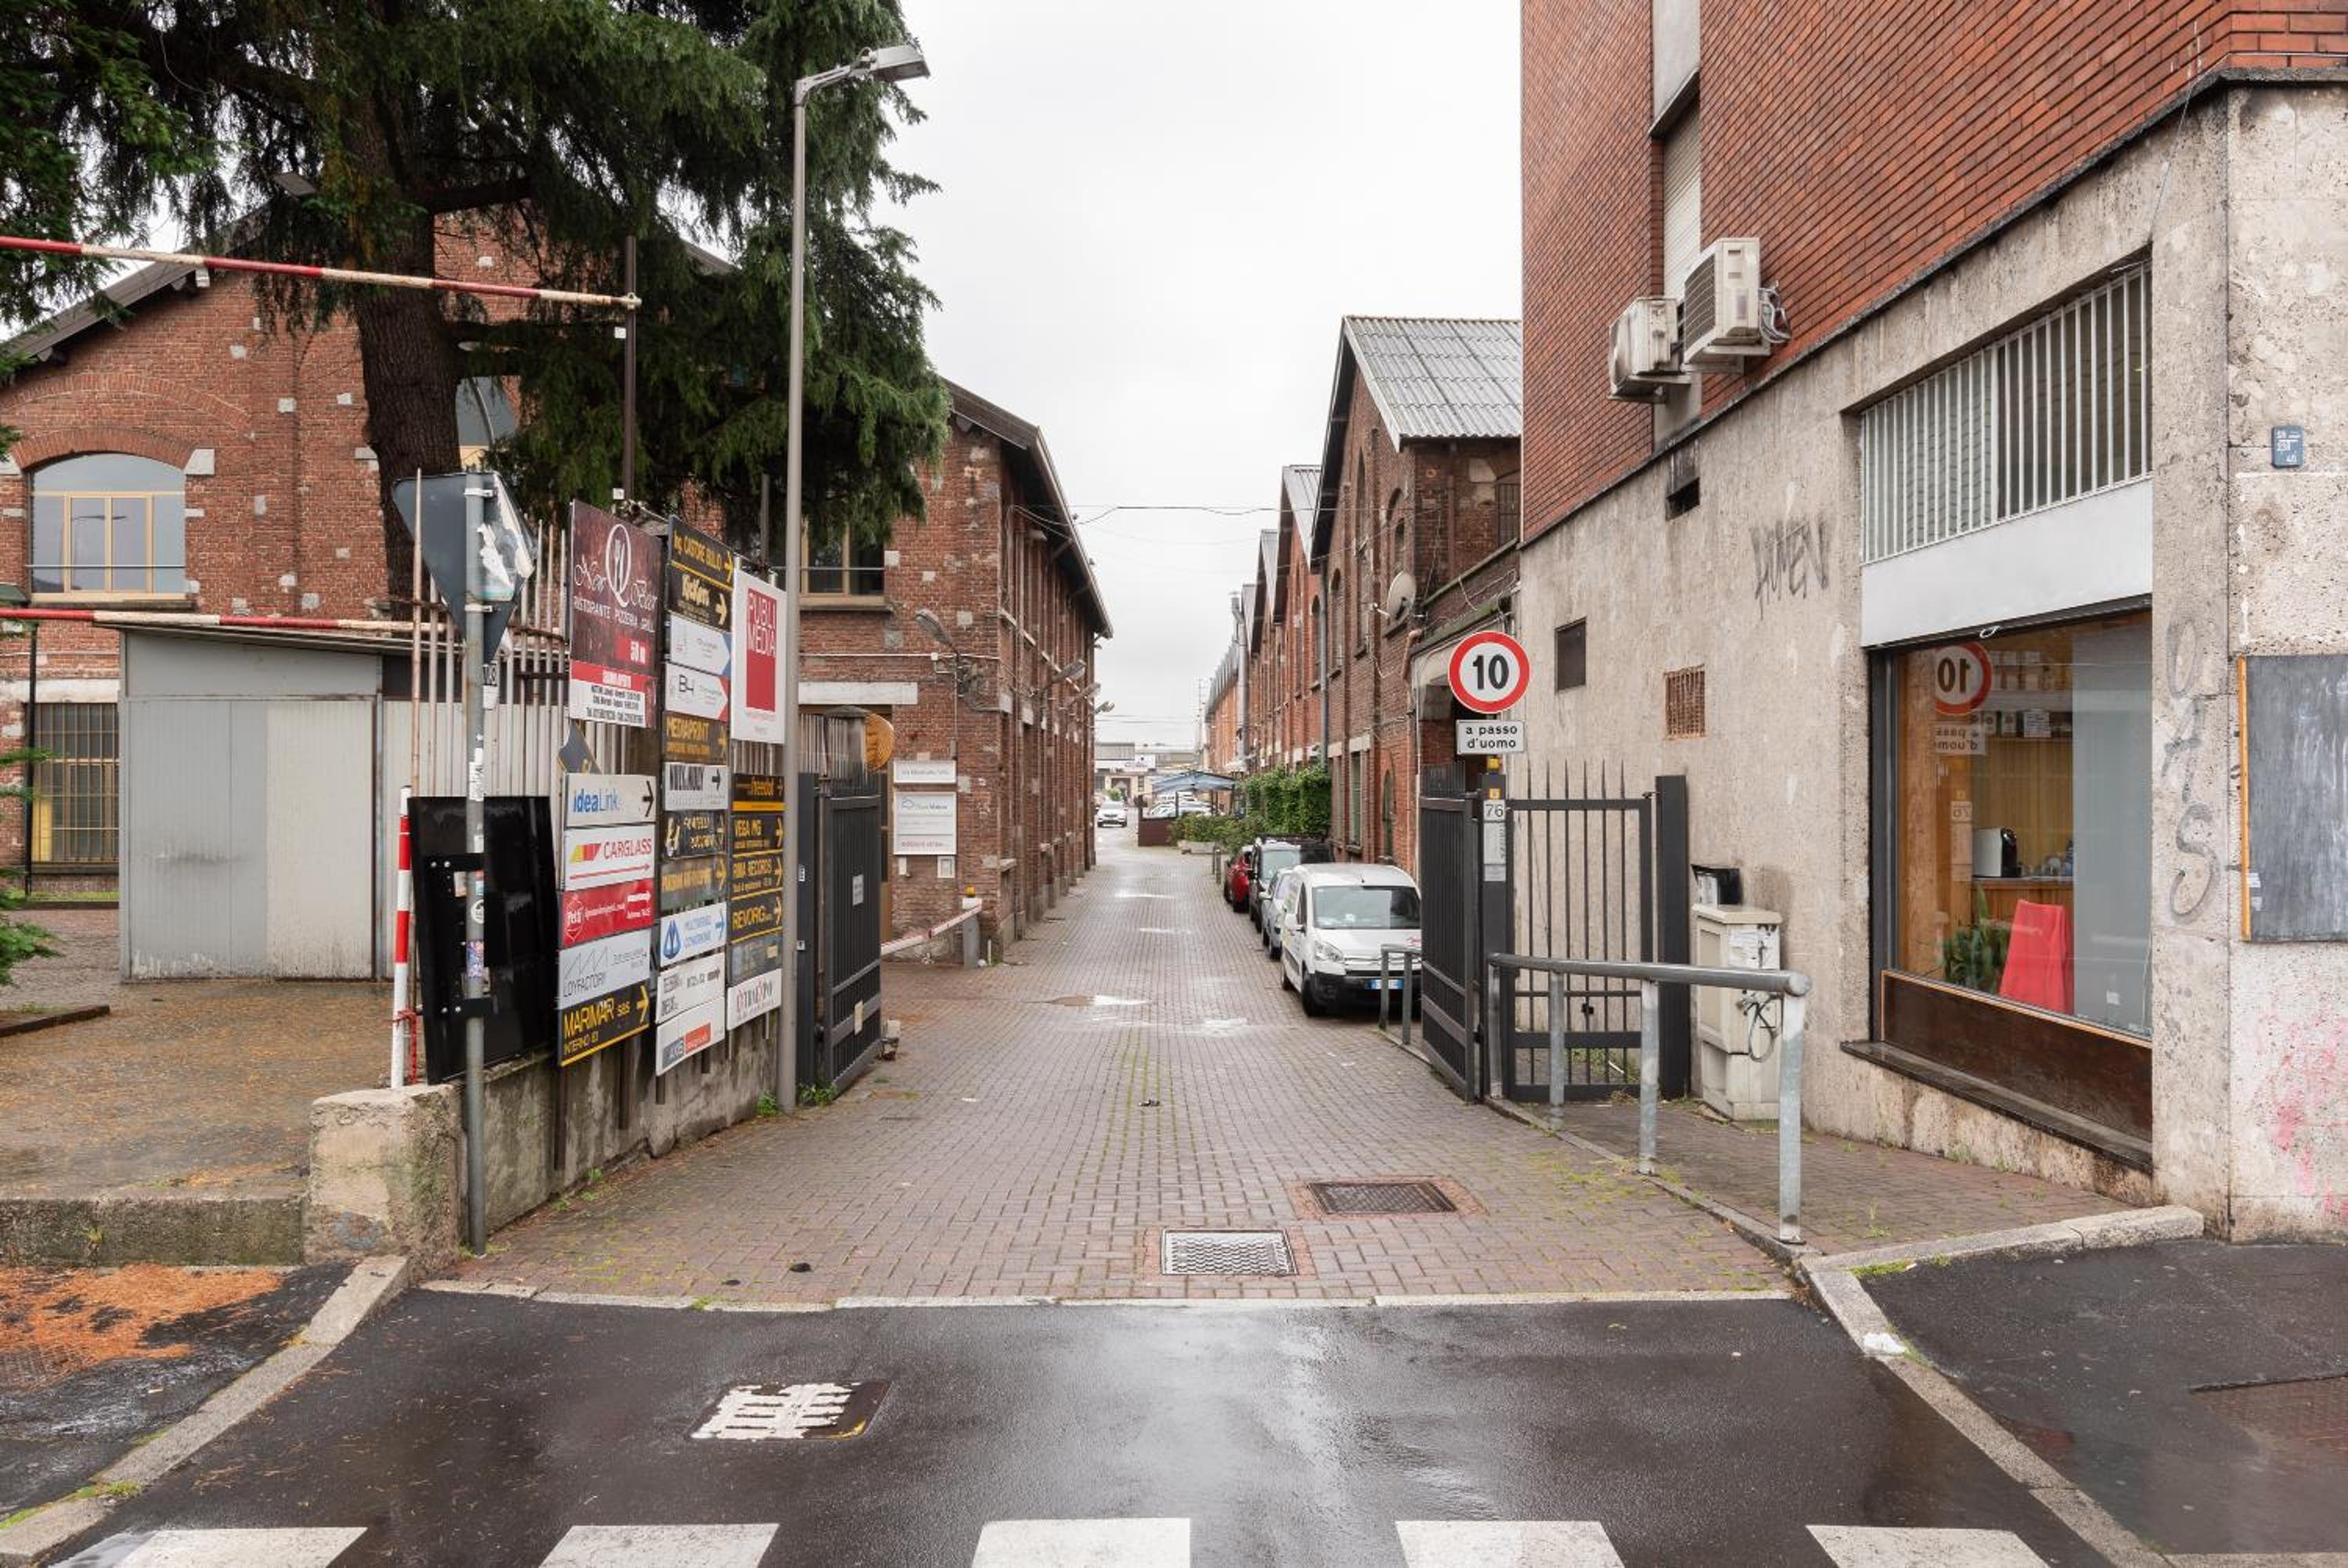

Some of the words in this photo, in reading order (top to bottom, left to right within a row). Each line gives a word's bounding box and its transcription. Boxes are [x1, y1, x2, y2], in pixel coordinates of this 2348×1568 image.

[747, 592, 776, 628] PUBLI
[747, 624, 776, 657] MEDIA
[1472, 654, 1509, 690] 10
[1479, 726, 1518, 736] passo
[1468, 738, 1516, 749] d'uomo
[1486, 804, 1504, 818] 76
[603, 838, 651, 859] CARGLASS
